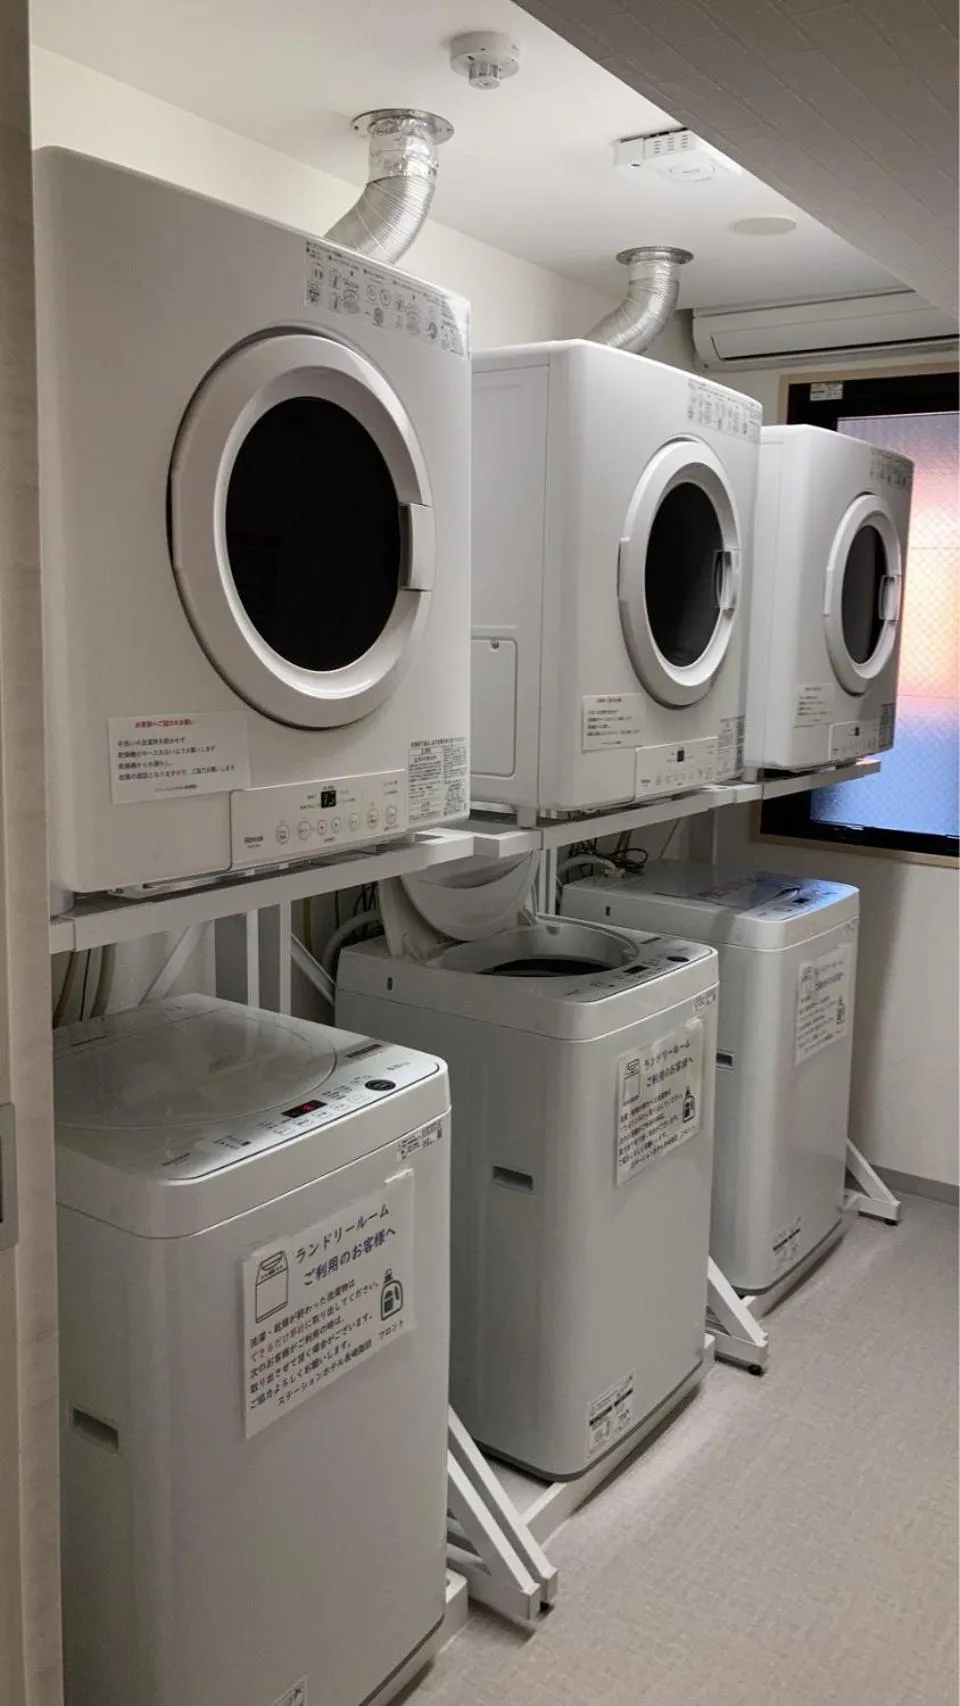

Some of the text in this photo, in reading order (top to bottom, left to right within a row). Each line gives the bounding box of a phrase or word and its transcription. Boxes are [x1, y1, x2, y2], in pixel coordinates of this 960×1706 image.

[295, 1203, 390, 1264] ランドリールーム
[303, 1228, 397, 1287] ご利用のお客様へ
